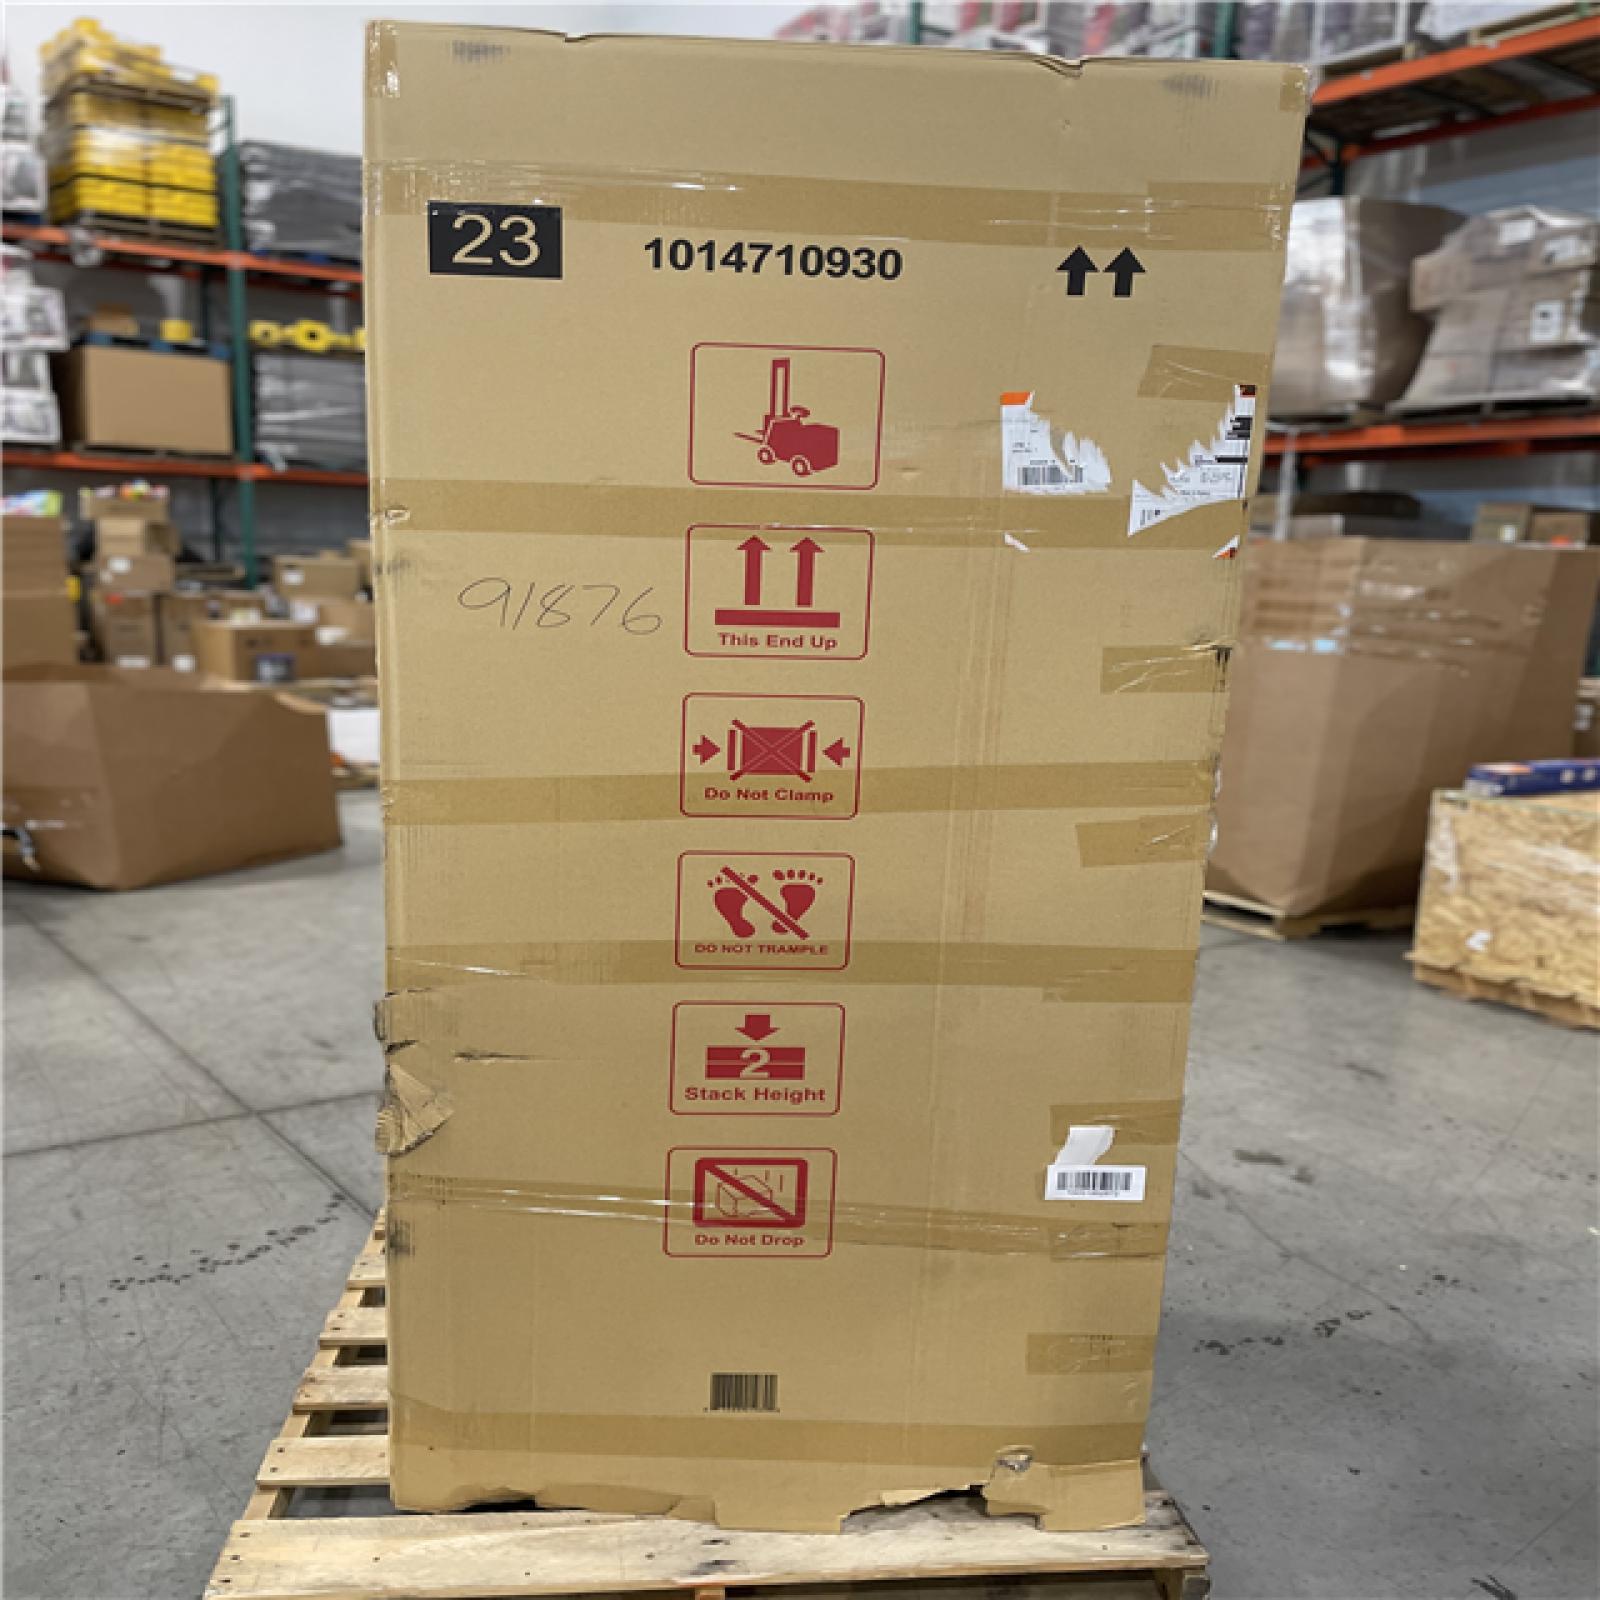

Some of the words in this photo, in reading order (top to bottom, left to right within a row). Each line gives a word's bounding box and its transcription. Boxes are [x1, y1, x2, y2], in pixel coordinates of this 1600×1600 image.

[450, 212, 542, 267] 23
[644, 236, 903, 282] 1014710930
[456, 576, 664, 637] 91876
[717, 631, 759, 648] This
[766, 633, 804, 649] End
[810, 635, 838, 651] Up
[704, 787, 732, 801] Do
[736, 787, 770, 802] Not
[774, 787, 835, 804] Clamp
[694, 942, 717, 955] DO
[720, 943, 753, 955] NOT
[757, 943, 829, 956] TRAMPLE
[739, 1047, 771, 1079] 2
[684, 1086, 746, 1102] Stack
[753, 1087, 827, 1105] Height
[694, 1234, 721, 1246] Do
[724, 1234, 756, 1247] Not
[761, 1234, 805, 1248] Drop
